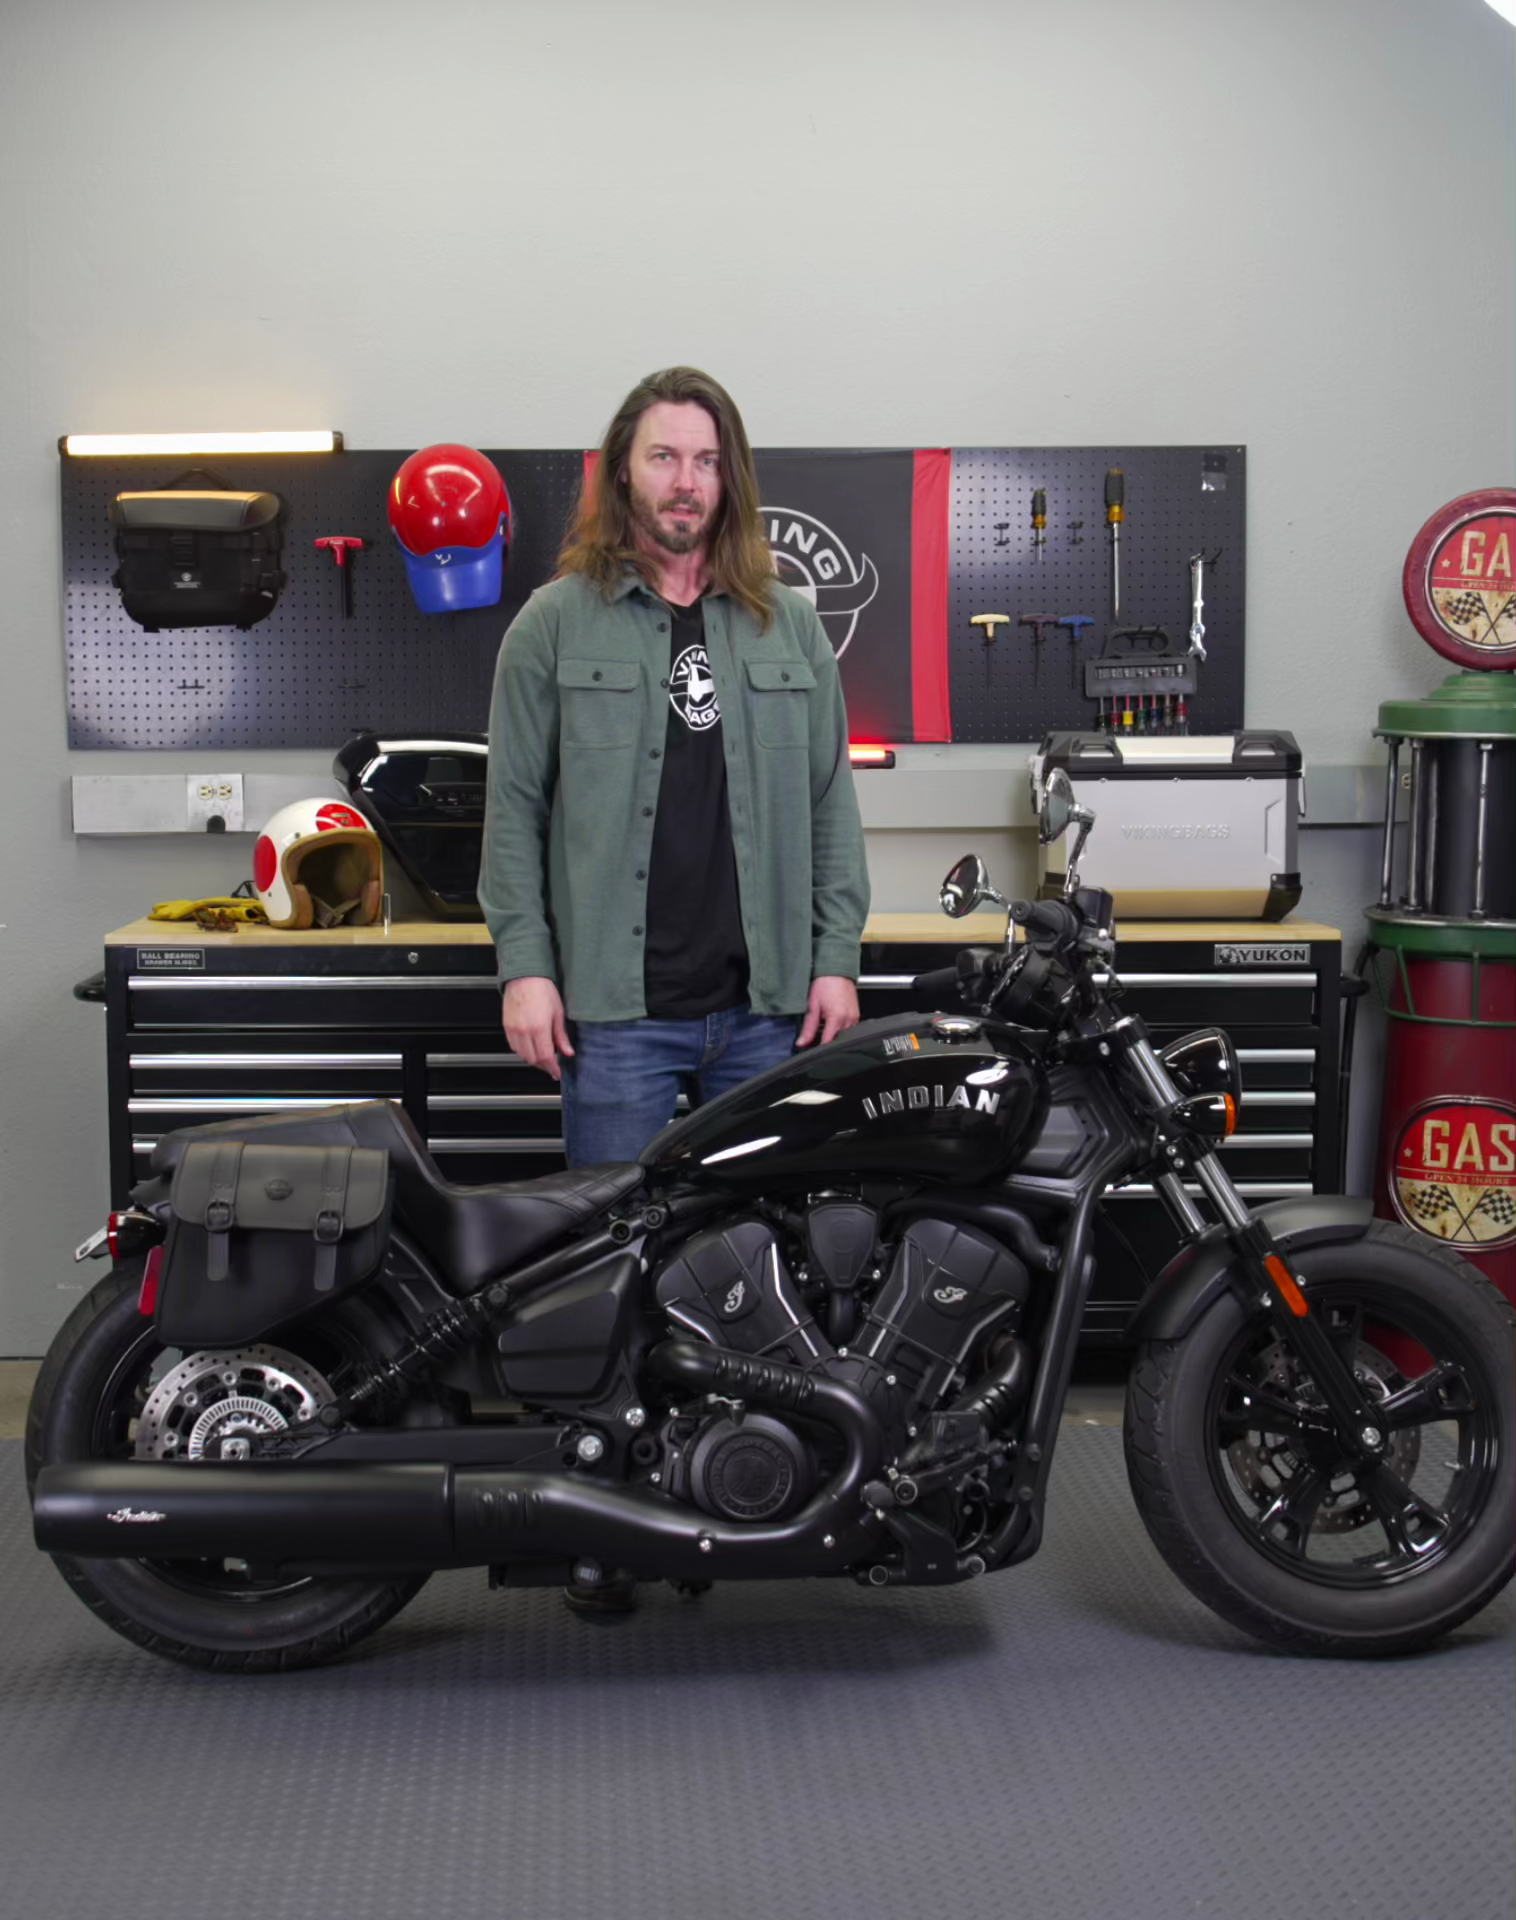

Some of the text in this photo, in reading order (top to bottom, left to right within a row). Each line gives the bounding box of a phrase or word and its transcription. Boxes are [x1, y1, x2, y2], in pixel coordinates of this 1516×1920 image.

[1460, 530, 1511, 577] GA
[1238, 949, 1306, 962] YUKON
[862, 1084, 1001, 1120] INDIAN
[1422, 1119, 1516, 1171] GAS
